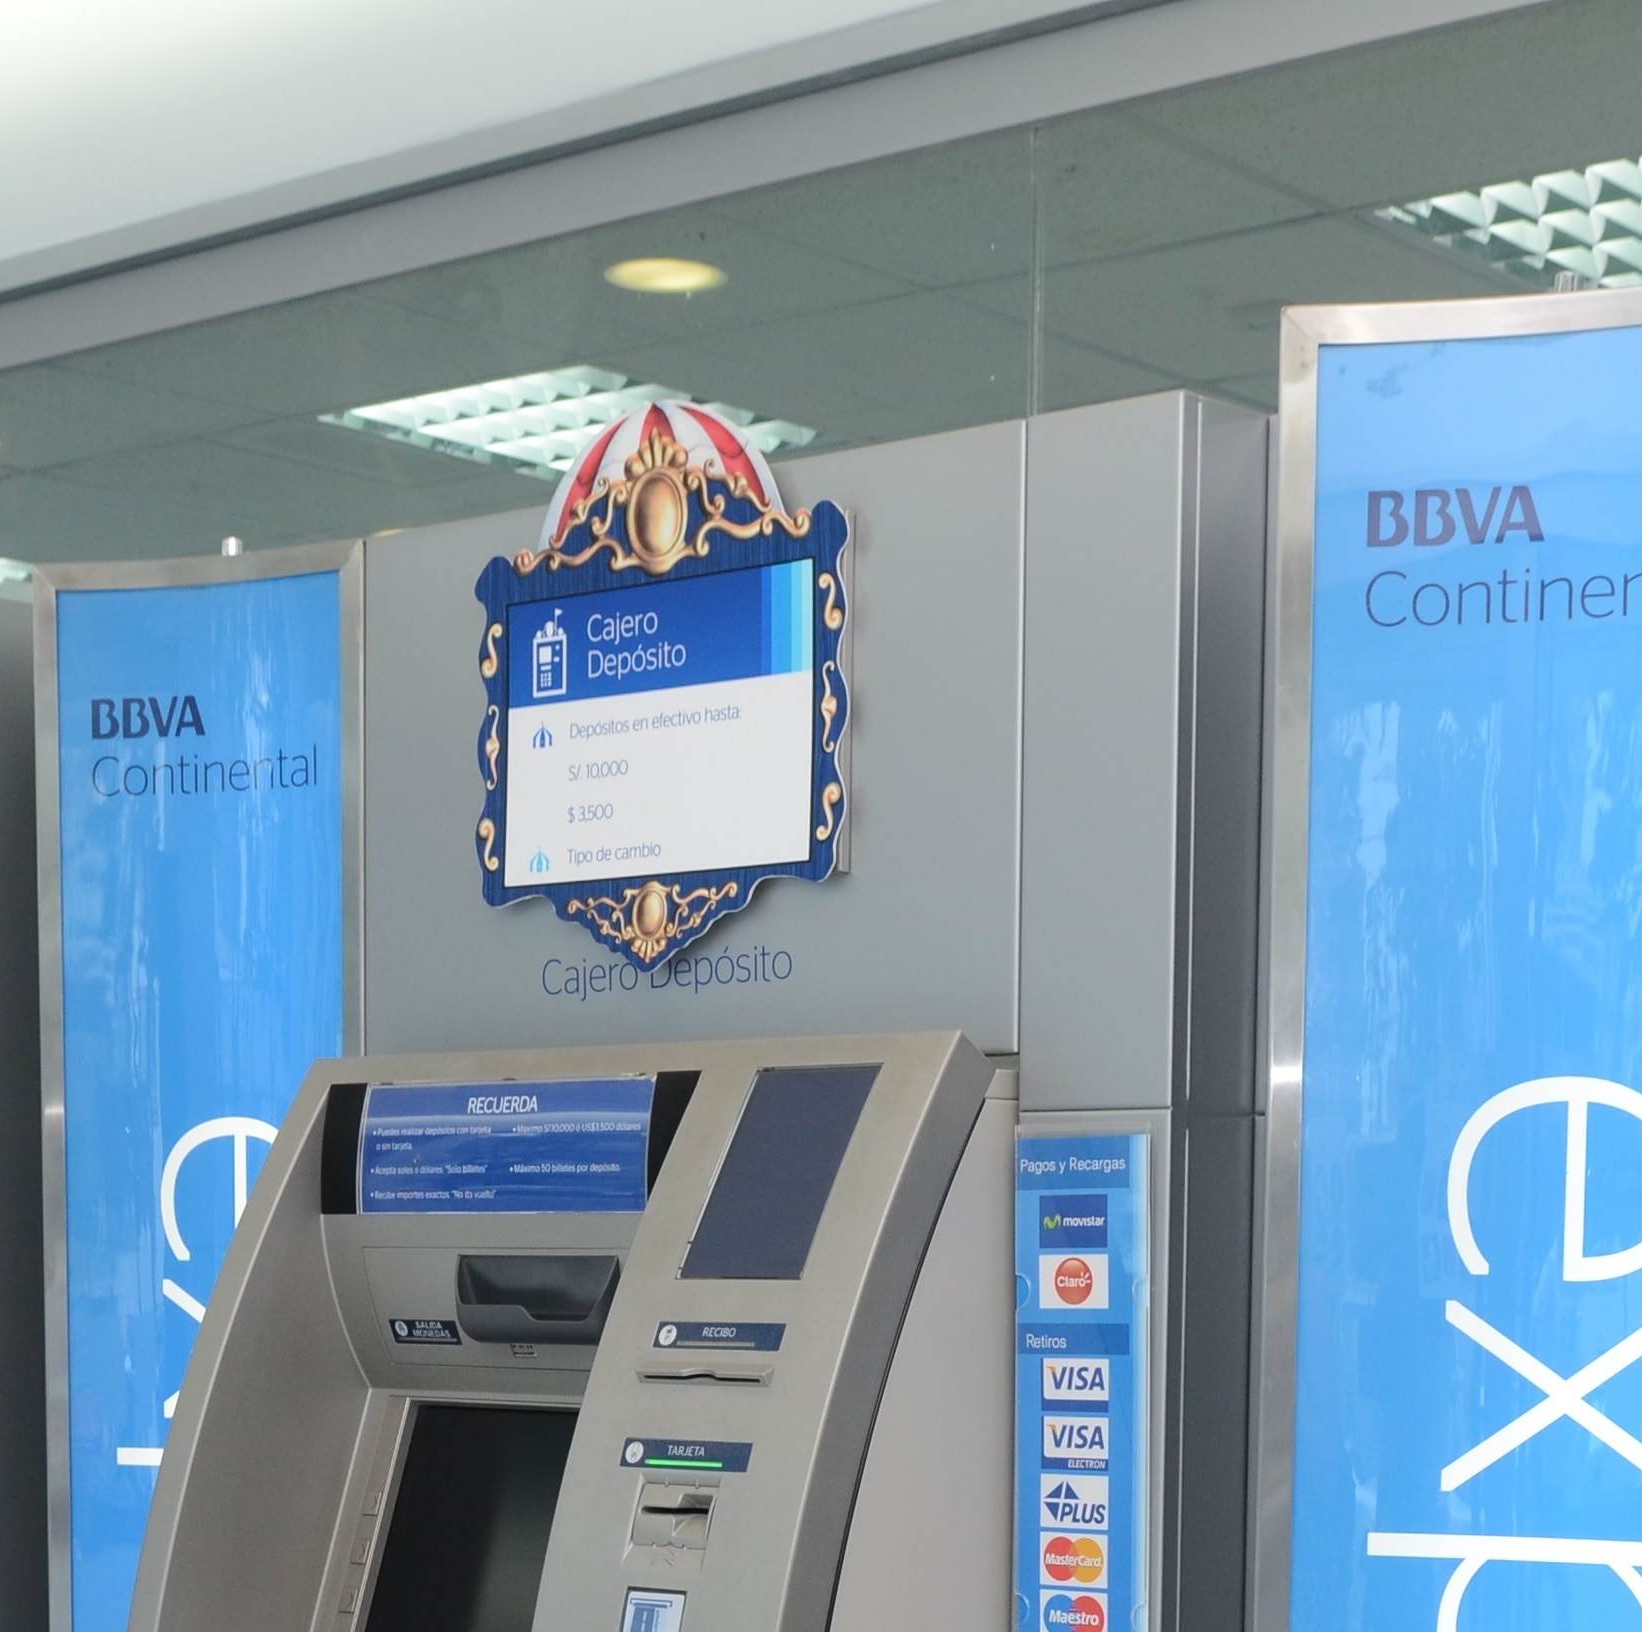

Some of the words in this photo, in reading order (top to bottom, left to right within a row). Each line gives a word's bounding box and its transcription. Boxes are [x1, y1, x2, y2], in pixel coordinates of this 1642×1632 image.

[1366, 485, 1544, 548] BBVA
[586, 609, 659, 645] Cajero
[587, 643, 687, 680] Depósito
[91, 695, 206, 740] BBVA
[569, 718, 629, 741] Depósitos
[633, 717, 648, 732] en
[652, 710, 701, 730] efectivo
[704, 705, 742, 723] hasta:
[92, 743, 317, 797] Continental
[586, 759, 629, 779] 10,000
[568, 806, 575, 824] $
[578, 803, 614, 823] 3,500
[567, 849, 593, 867] Tipo
[596, 847, 612, 862] de
[614, 842, 661, 861] cambio
[541, 958, 639, 1002] Cajero
[650, 946, 793, 994] Depósito
[467, 1095, 538, 1114] RECUERDA
[577, 1164, 588, 1173] por
[1020, 1159, 1056, 1174] Pagos
[1058, 1161, 1066, 1174] y
[1069, 1157, 1126, 1174] Recargas
[1062, 1215, 1105, 1227] movistar
[1057, 1275, 1087, 1288] Claro
[415, 1321, 442, 1329] SALIDA
[702, 1327, 736, 1338] RECIBO
[1026, 1334, 1067, 1349] Retiros
[1047, 1366, 1105, 1391] VISA
[1047, 1424, 1105, 1450] VISA
[667, 1445, 705, 1457] TARJETA
[1067, 1459, 1106, 1470] ELECTRON
[1059, 1503, 1106, 1524] PLUS
[1045, 1552, 1102, 1568] MasterCard
[1049, 1608, 1100, 1627] Maestro
